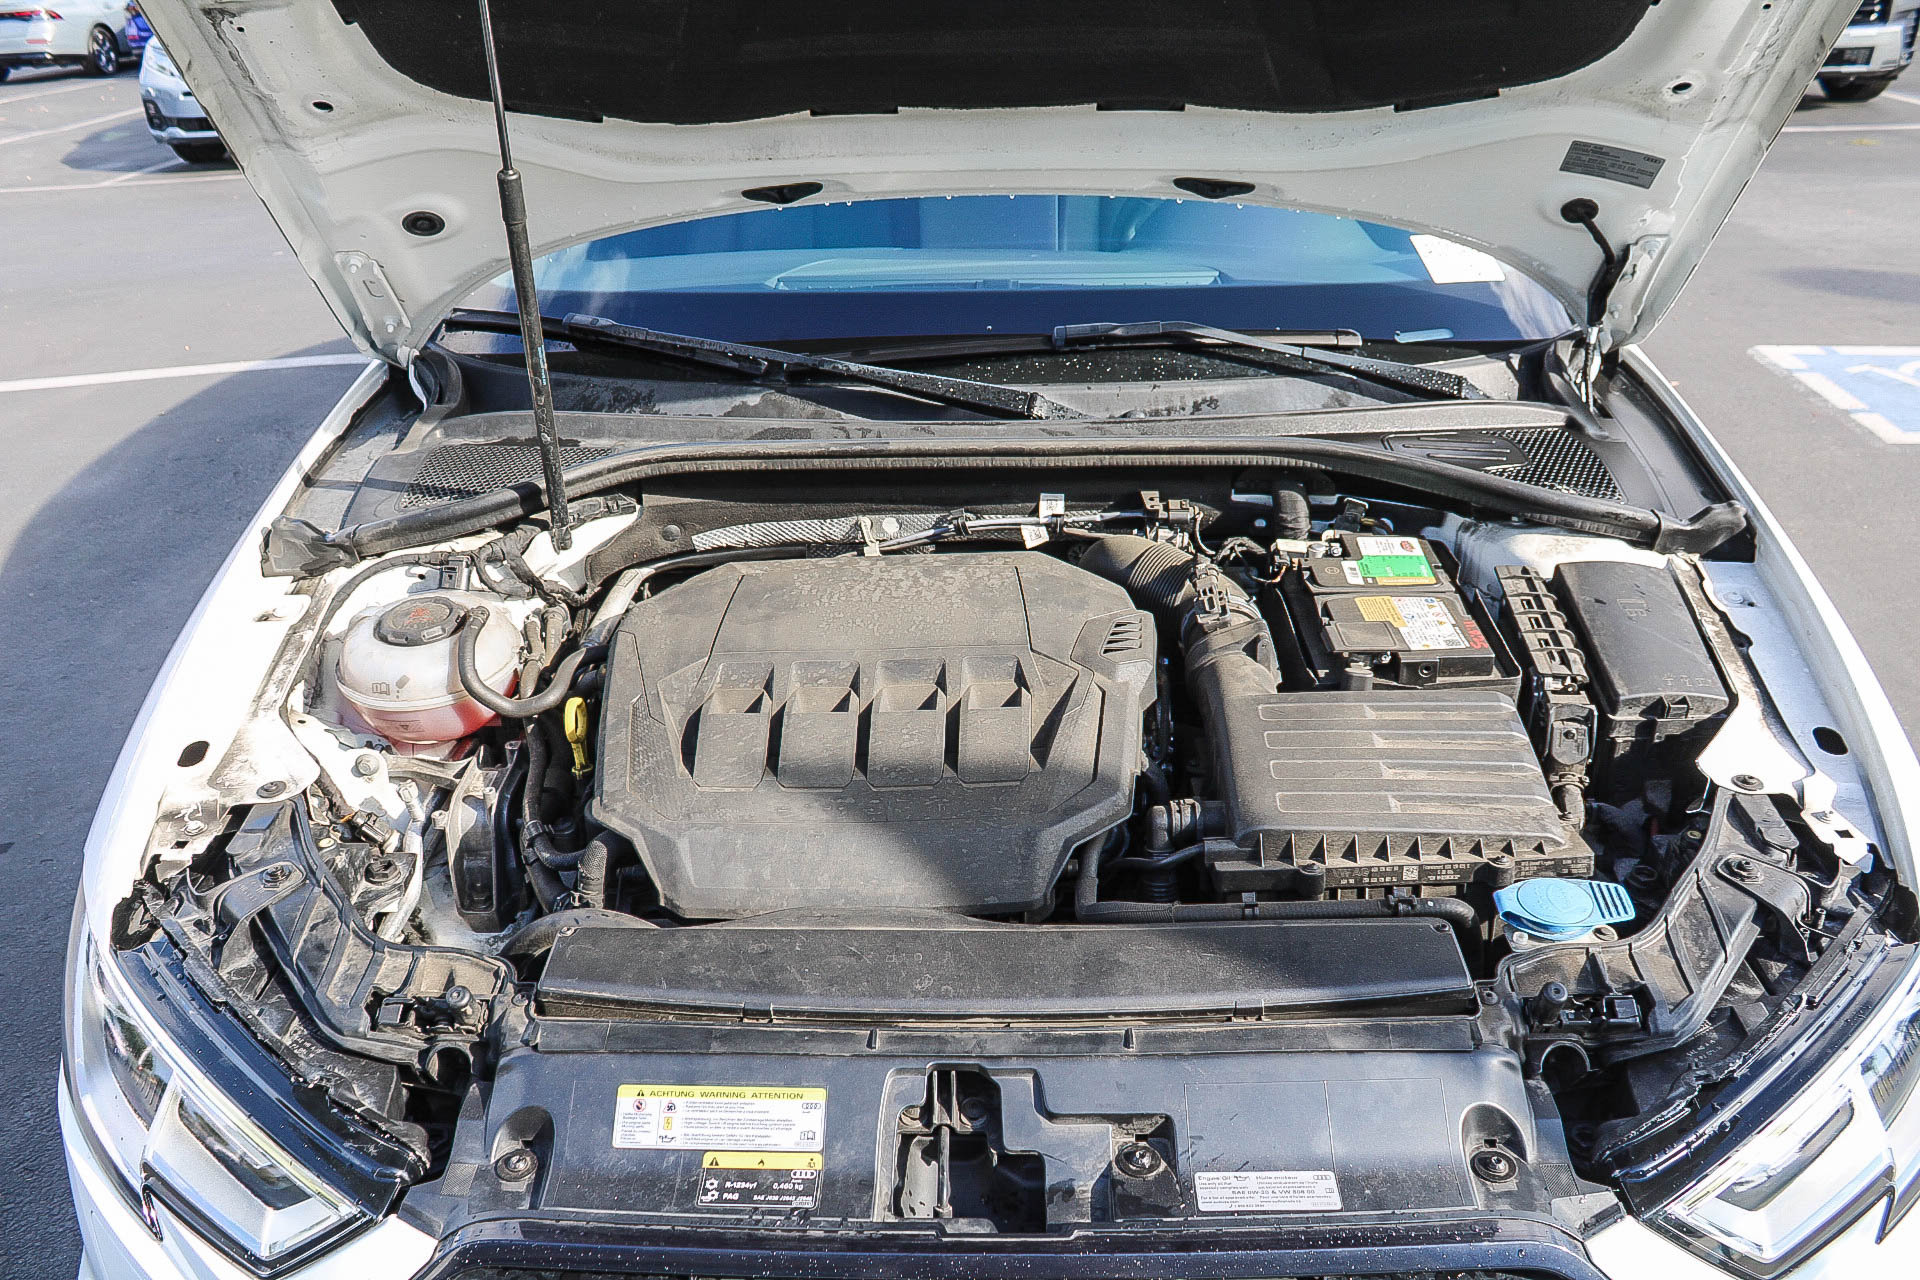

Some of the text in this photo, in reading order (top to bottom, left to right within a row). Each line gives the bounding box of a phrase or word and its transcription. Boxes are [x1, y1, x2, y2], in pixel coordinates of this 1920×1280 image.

[649, 1090, 804, 1100] ACHTUNG WARNING ATTENTION
[722, 1192, 740, 1200] PAG
